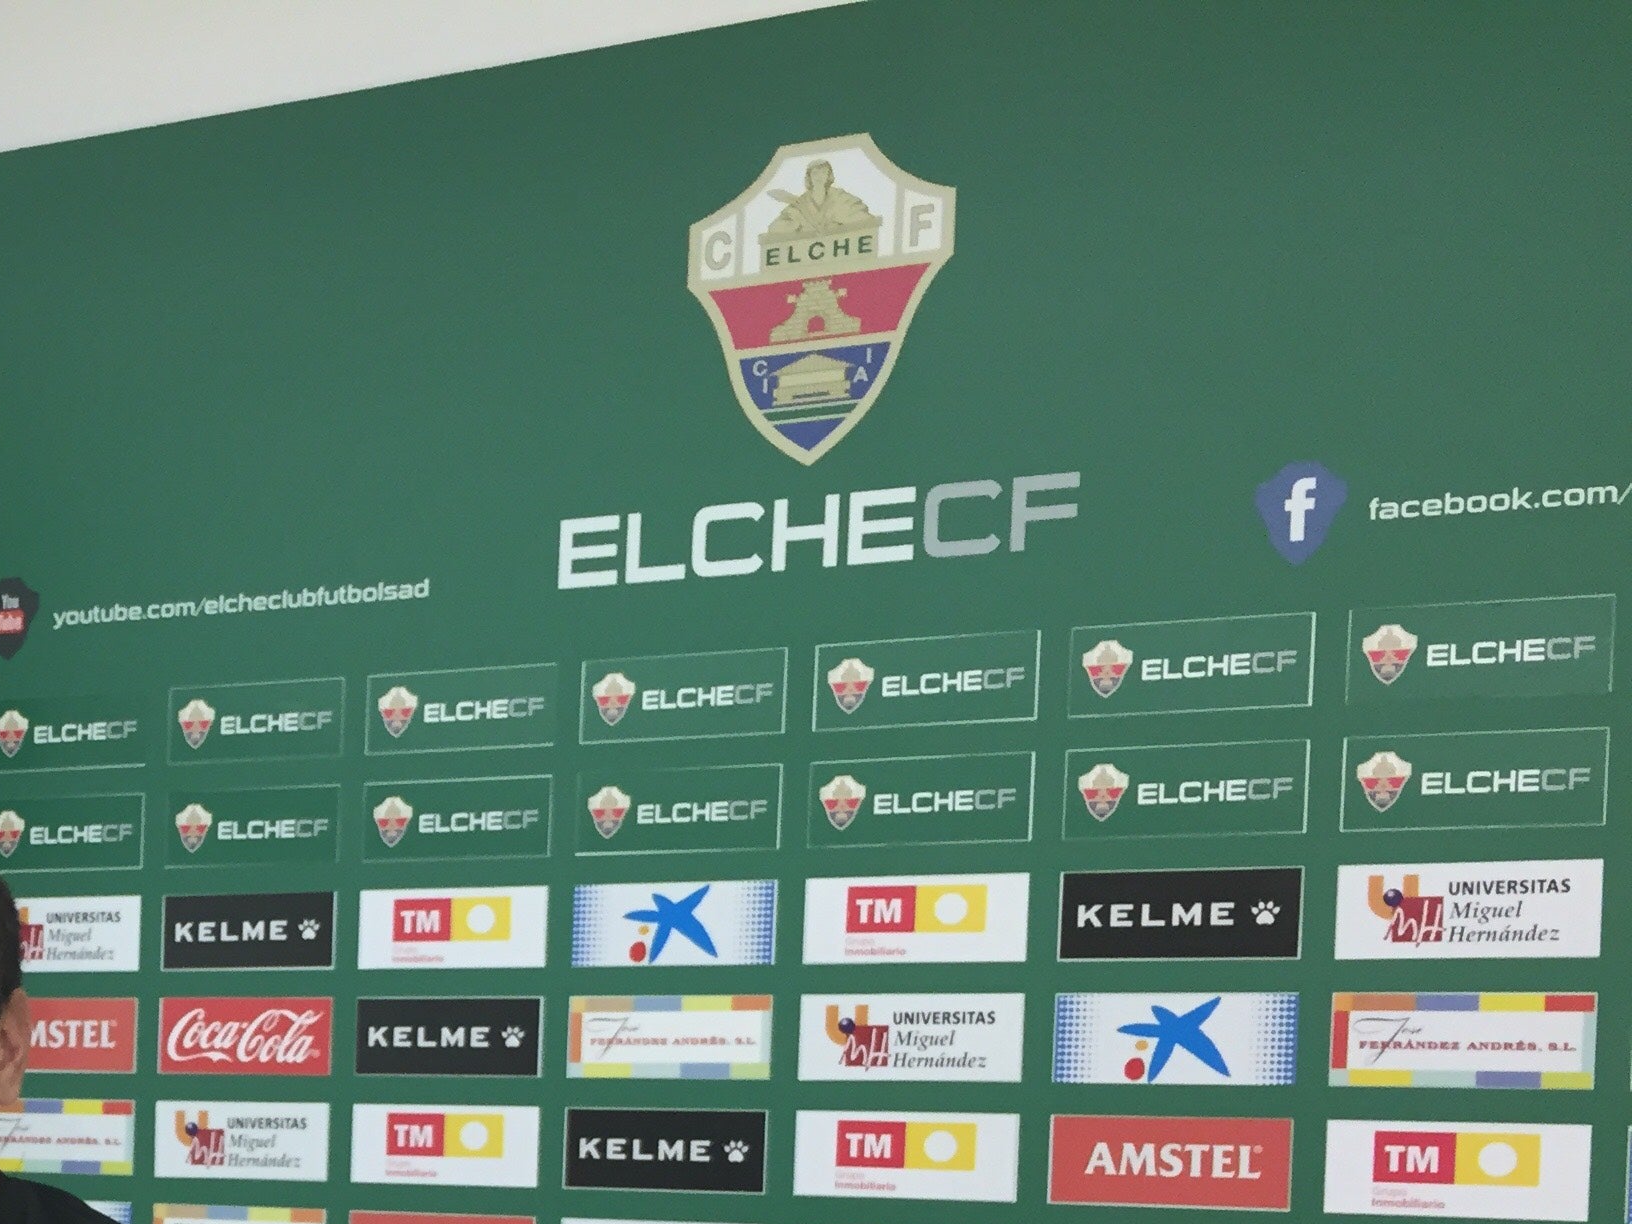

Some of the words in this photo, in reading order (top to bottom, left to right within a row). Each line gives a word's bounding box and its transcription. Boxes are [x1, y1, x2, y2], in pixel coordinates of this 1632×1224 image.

[765, 234, 874, 266] ELCHE
[557, 471, 1081, 589] ELCHECF
[52, 577, 431, 630] youtube.com/elcheclubfutbolsad
[1426, 635, 1596, 668] ELCHECF
[1141, 649, 1298, 682] ELCHECF
[881, 666, 1026, 697] ELCHECF
[423, 695, 545, 725] ELCHECF
[641, 682, 774, 711] ELCHECF
[33, 720, 138, 744] ELCHECF
[220, 711, 333, 736] ELCHECF
[1137, 776, 1294, 806] ELCHECF
[1420, 766, 1591, 796] ELCHECF
[636, 799, 768, 825] ELCHECF
[873, 787, 1017, 815] ELCHECF
[29, 823, 133, 846] ELCHECF
[216, 817, 329, 842] ELCHECF
[418, 808, 539, 835] ELCHECF
[1448, 878, 1572, 897] UNIVERSITAS
[45, 911, 122, 925] UNIVERSITAS
[399, 908, 441, 934] TM
[855, 897, 902, 925] TM
[1076, 901, 1237, 929] KELME
[1449, 900, 1522, 924] Miguel
[173, 920, 289, 943] KELME
[1448, 923, 1561, 944] Hernández
[893, 1009, 996, 1026] UNIVERSITAS
[30, 1019, 118, 1050] MSTEL
[167, 1008, 325, 1064] Coca-Cola
[368, 1025, 492, 1049] KELME
[894, 1029, 956, 1050] Miguel
[893, 1050, 987, 1069] Hernández
[227, 1117, 308, 1131] UNIVERSITAS
[393, 1123, 434, 1148] TM
[578, 1137, 712, 1163] KELME
[845, 1132, 892, 1160] TM
[1383, 1145, 1440, 1174] TM
[1084, 1141, 1262, 1180] AMSTEL
